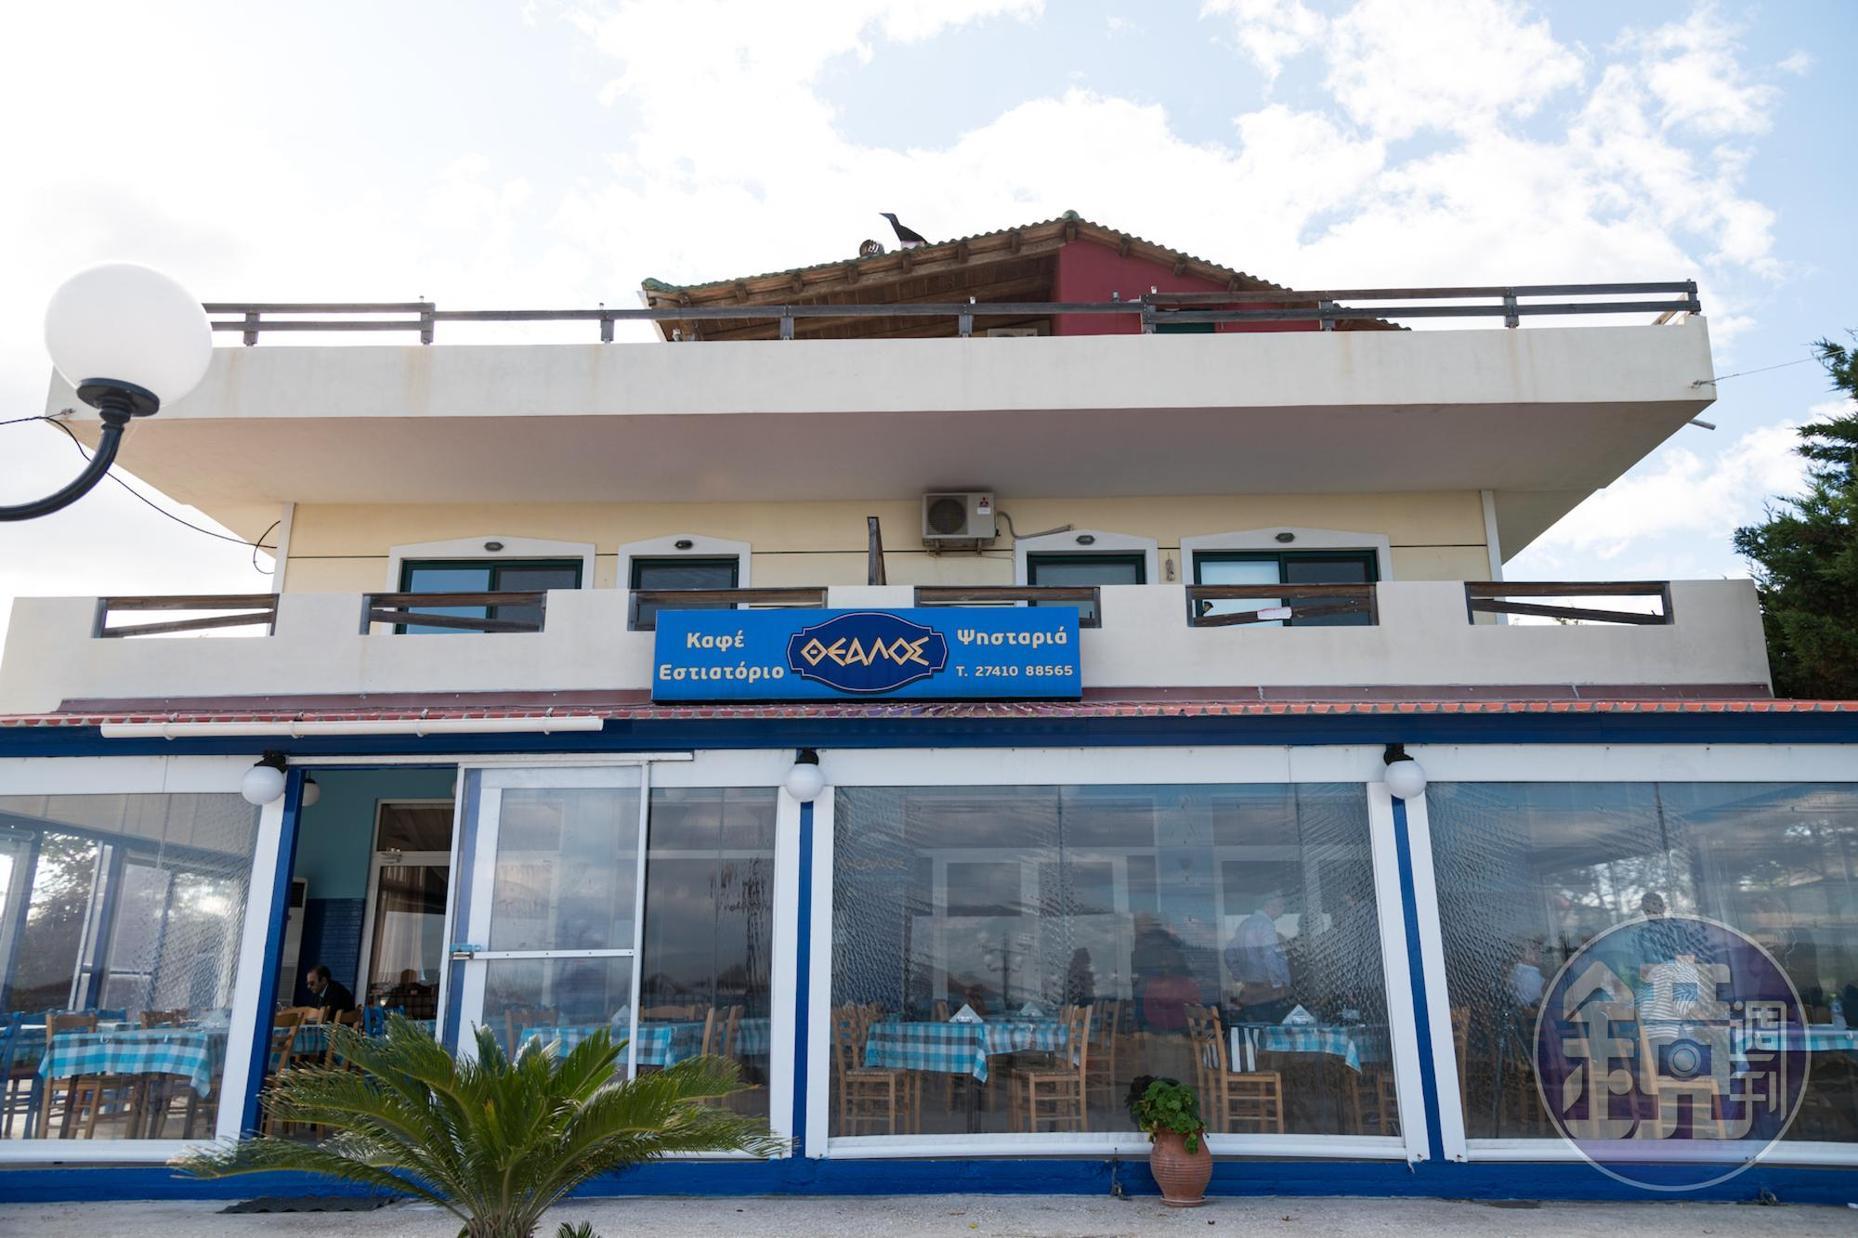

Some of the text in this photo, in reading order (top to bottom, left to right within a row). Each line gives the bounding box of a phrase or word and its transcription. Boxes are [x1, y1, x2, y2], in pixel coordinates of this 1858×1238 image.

[686, 630, 745, 652] Καφέ
[957, 626, 1068, 649] Ψησταριά
[659, 661, 785, 684] Εστιατόριο
[975, 665, 1019, 677] 27410
[1025, 665, 1074, 676] 88565
